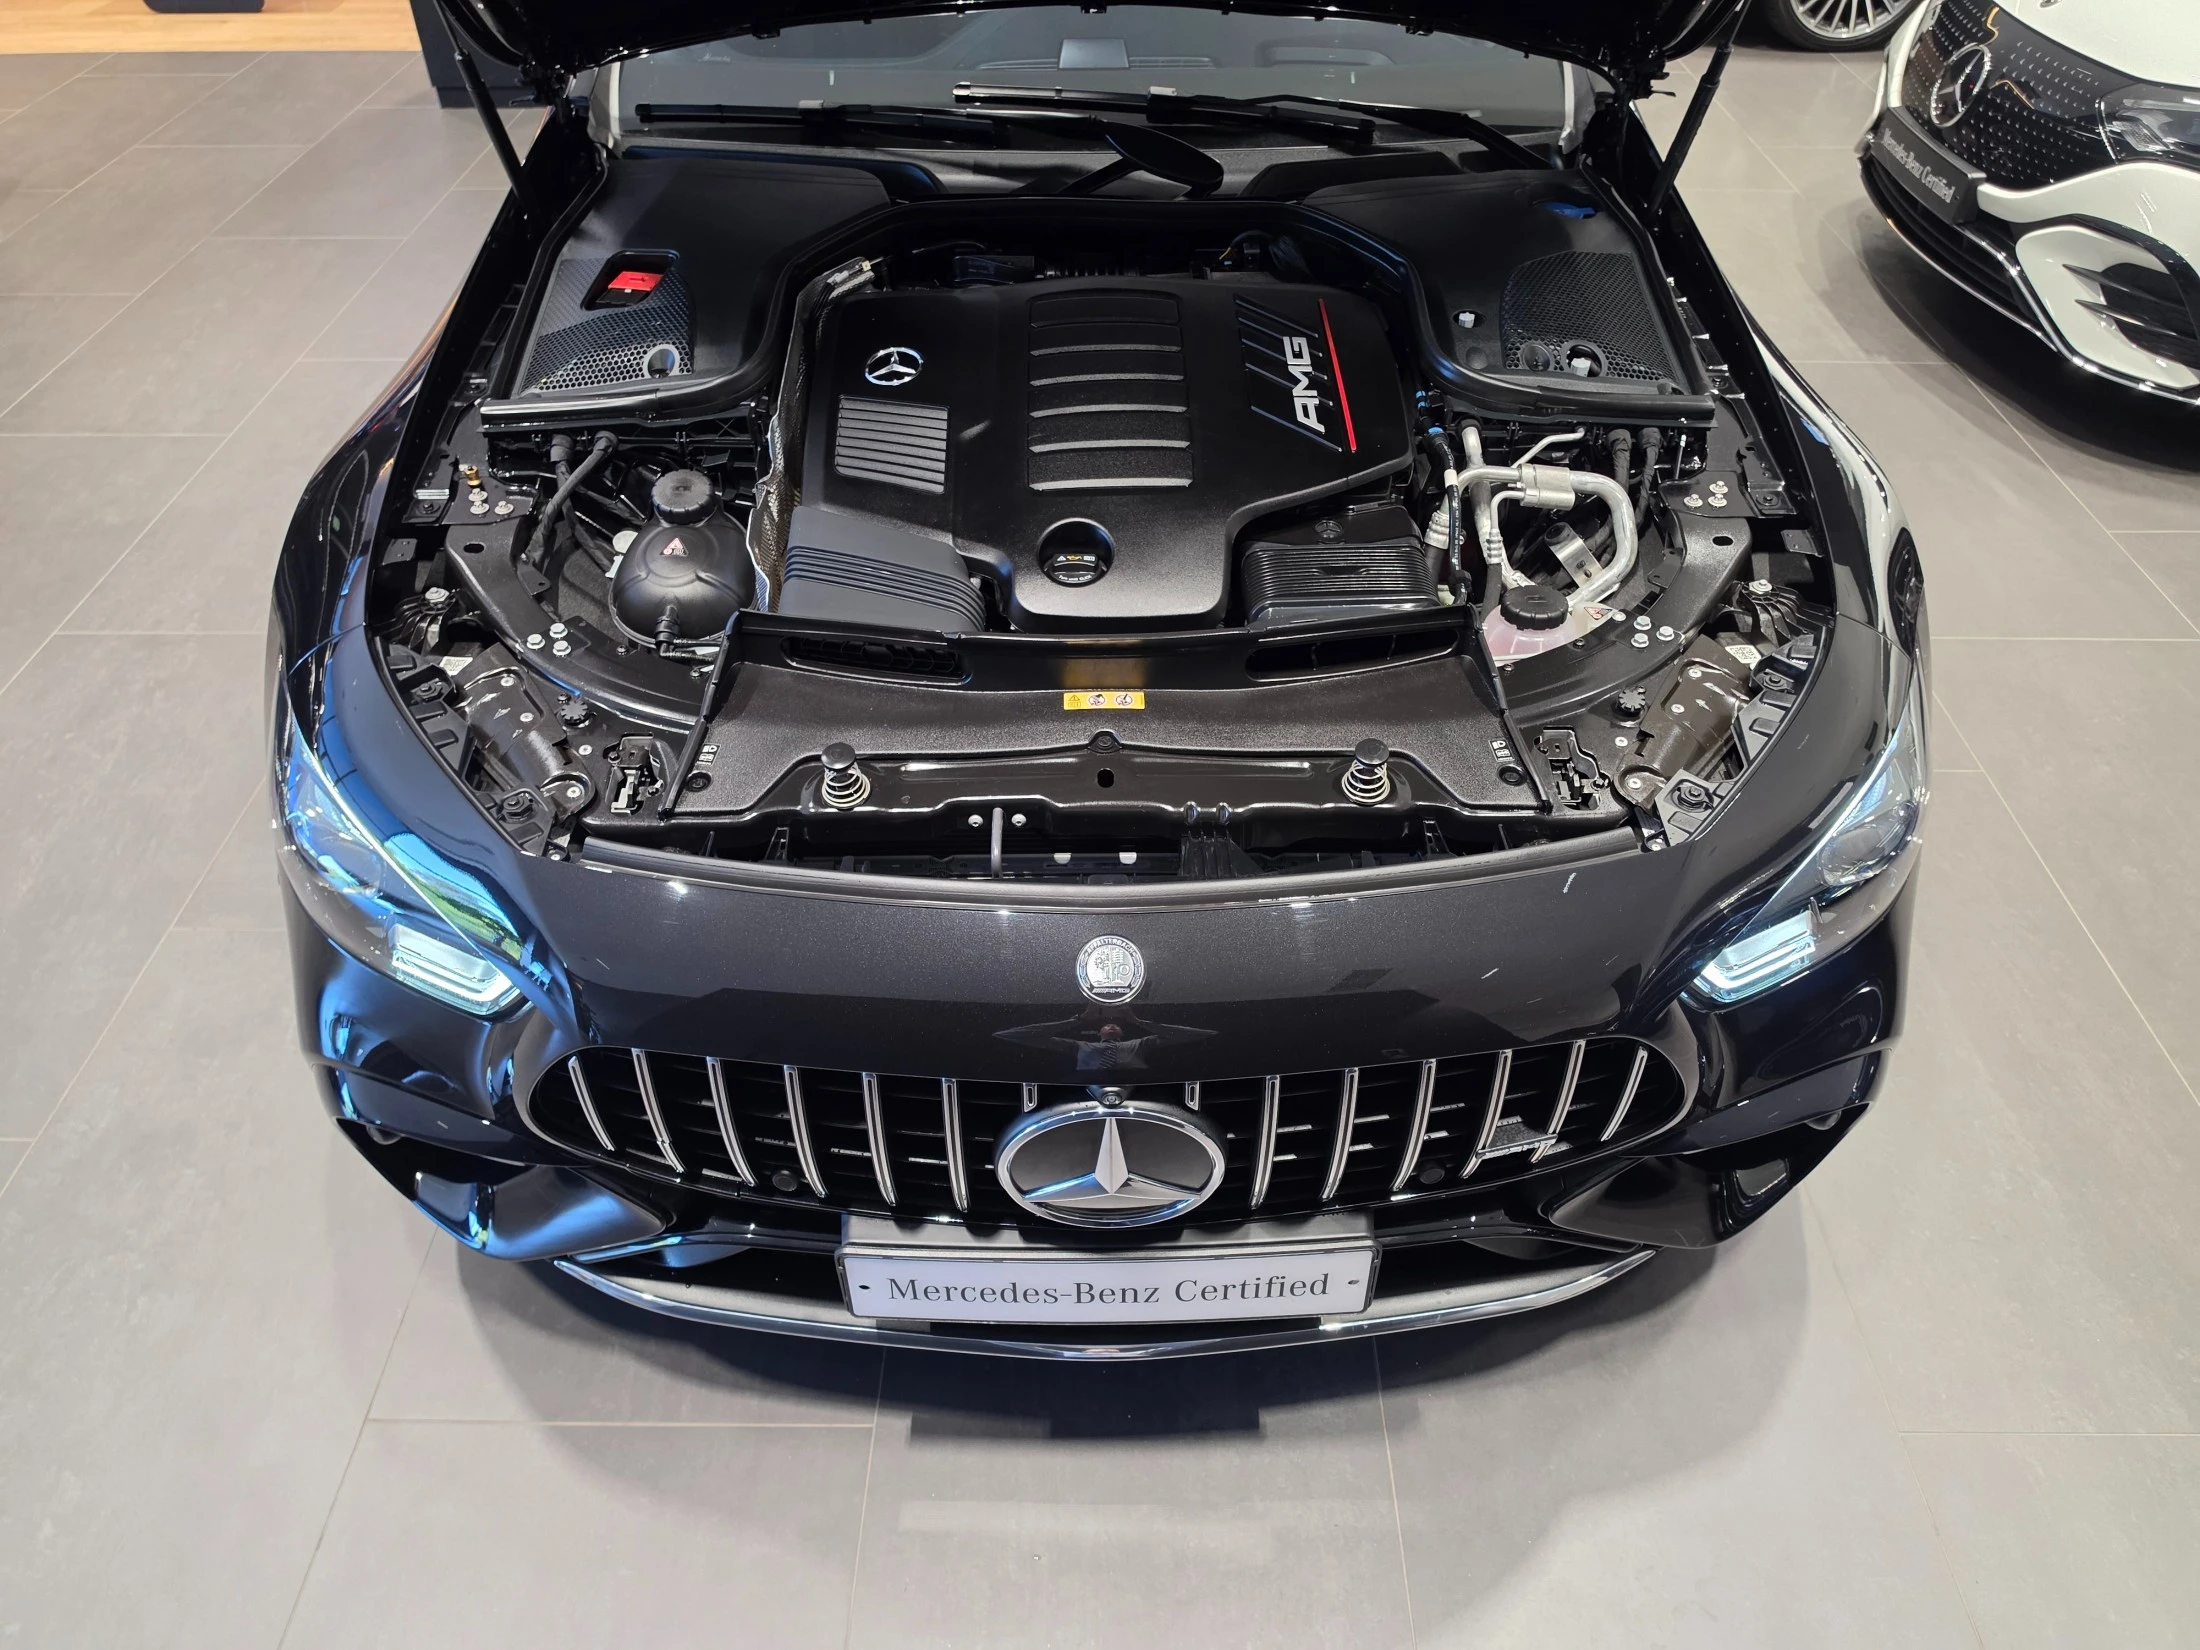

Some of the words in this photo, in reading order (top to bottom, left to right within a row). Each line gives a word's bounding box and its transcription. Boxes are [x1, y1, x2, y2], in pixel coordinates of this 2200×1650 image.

[1881, 128, 1923, 179] Mercedes-Benz
[1921, 166, 1955, 203] Certified
[1282, 336, 1325, 434] AMG
[886, 1277, 1160, 1304] Mercedes-Benz
[1175, 1272, 1329, 1302] Certified
